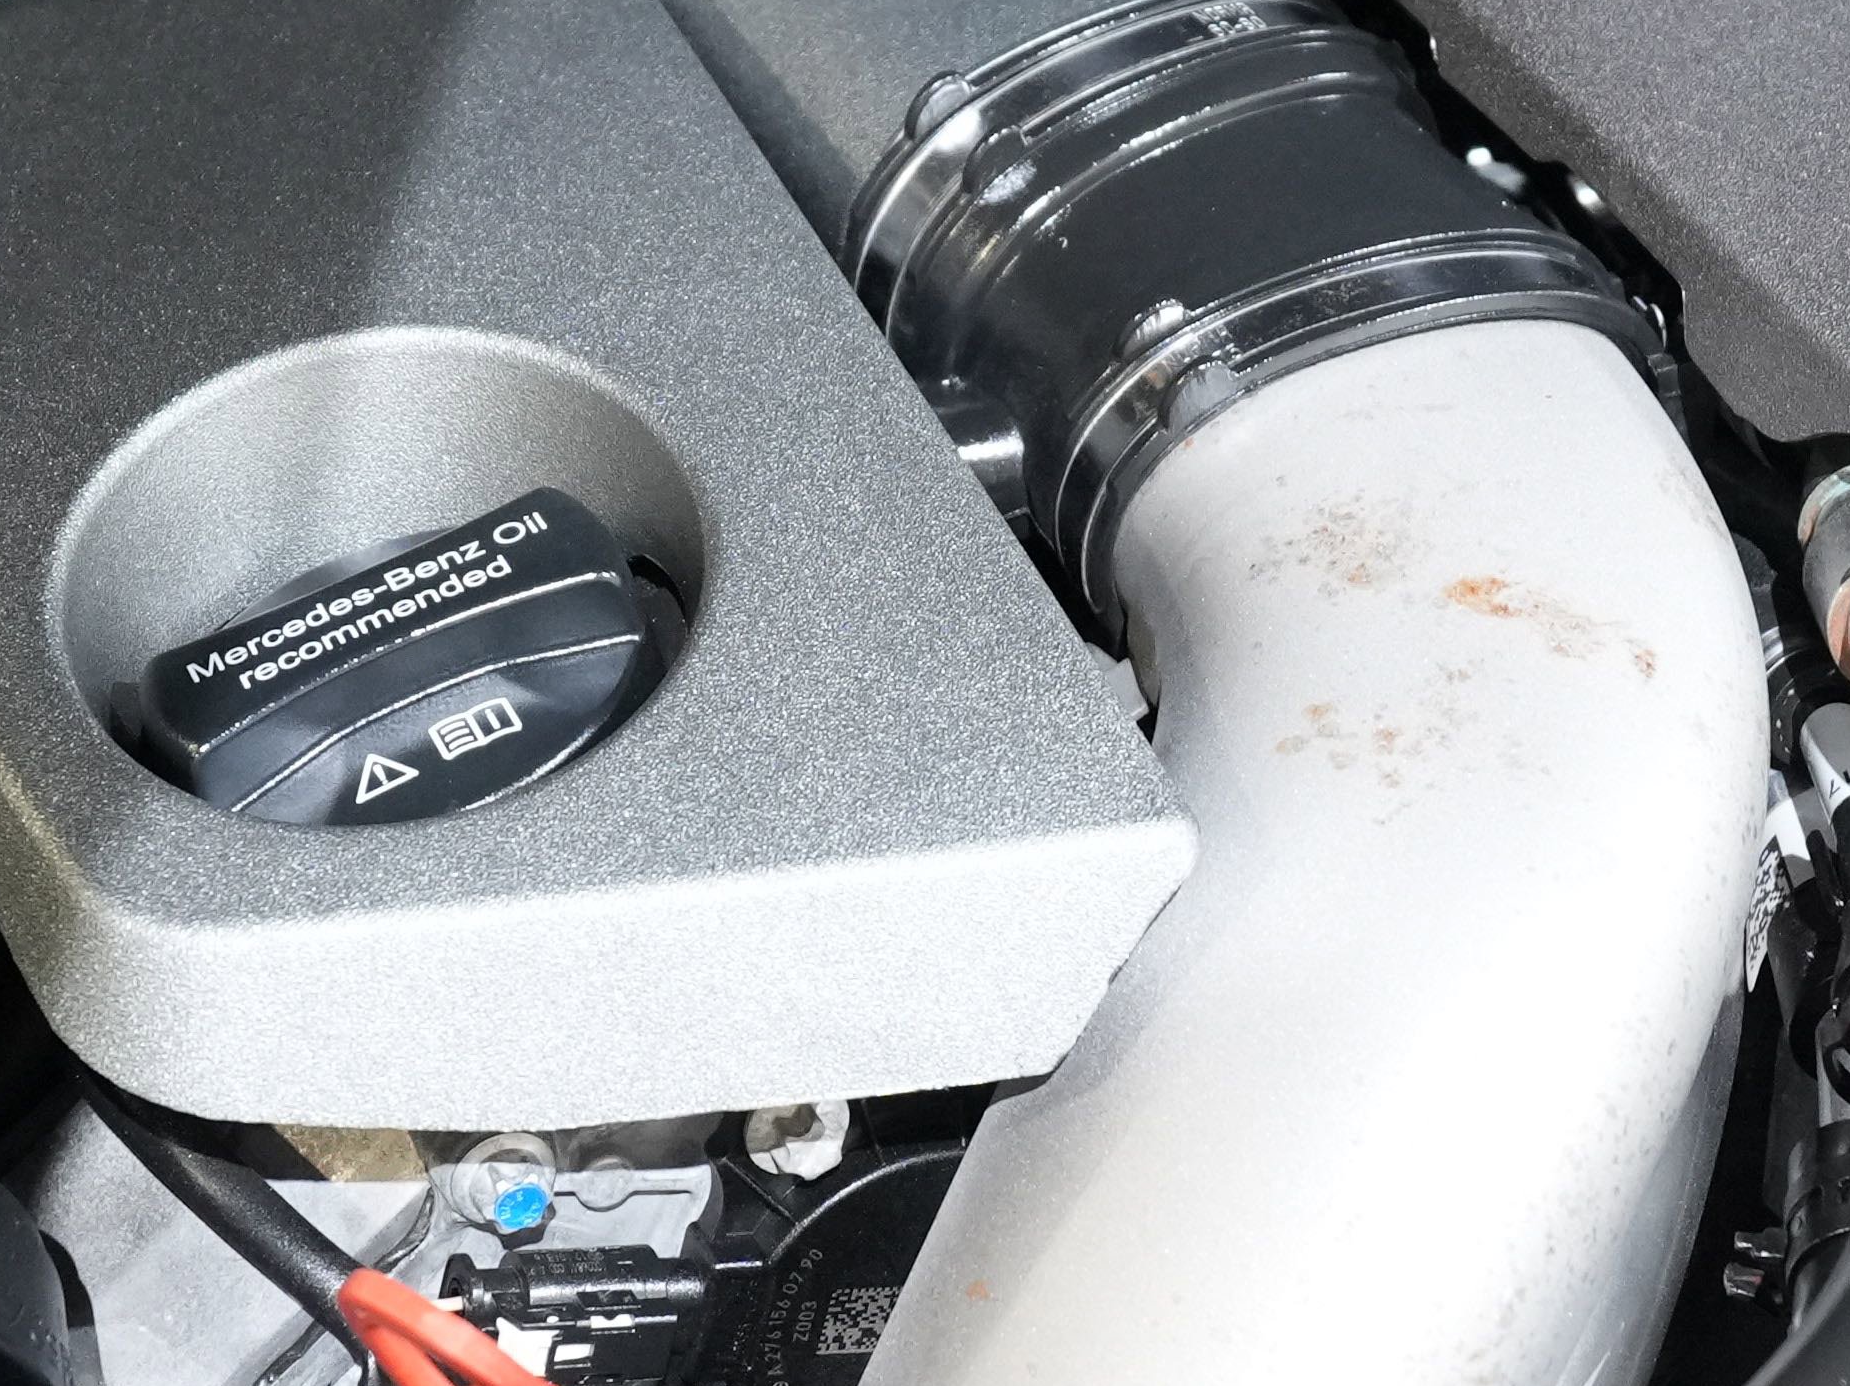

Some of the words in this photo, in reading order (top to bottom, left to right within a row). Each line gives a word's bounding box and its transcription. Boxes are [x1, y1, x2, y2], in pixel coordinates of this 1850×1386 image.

[185, 540, 489, 684] Mercedes-Benz
[493, 511, 549, 550] Oil
[238, 555, 513, 690] recommended
